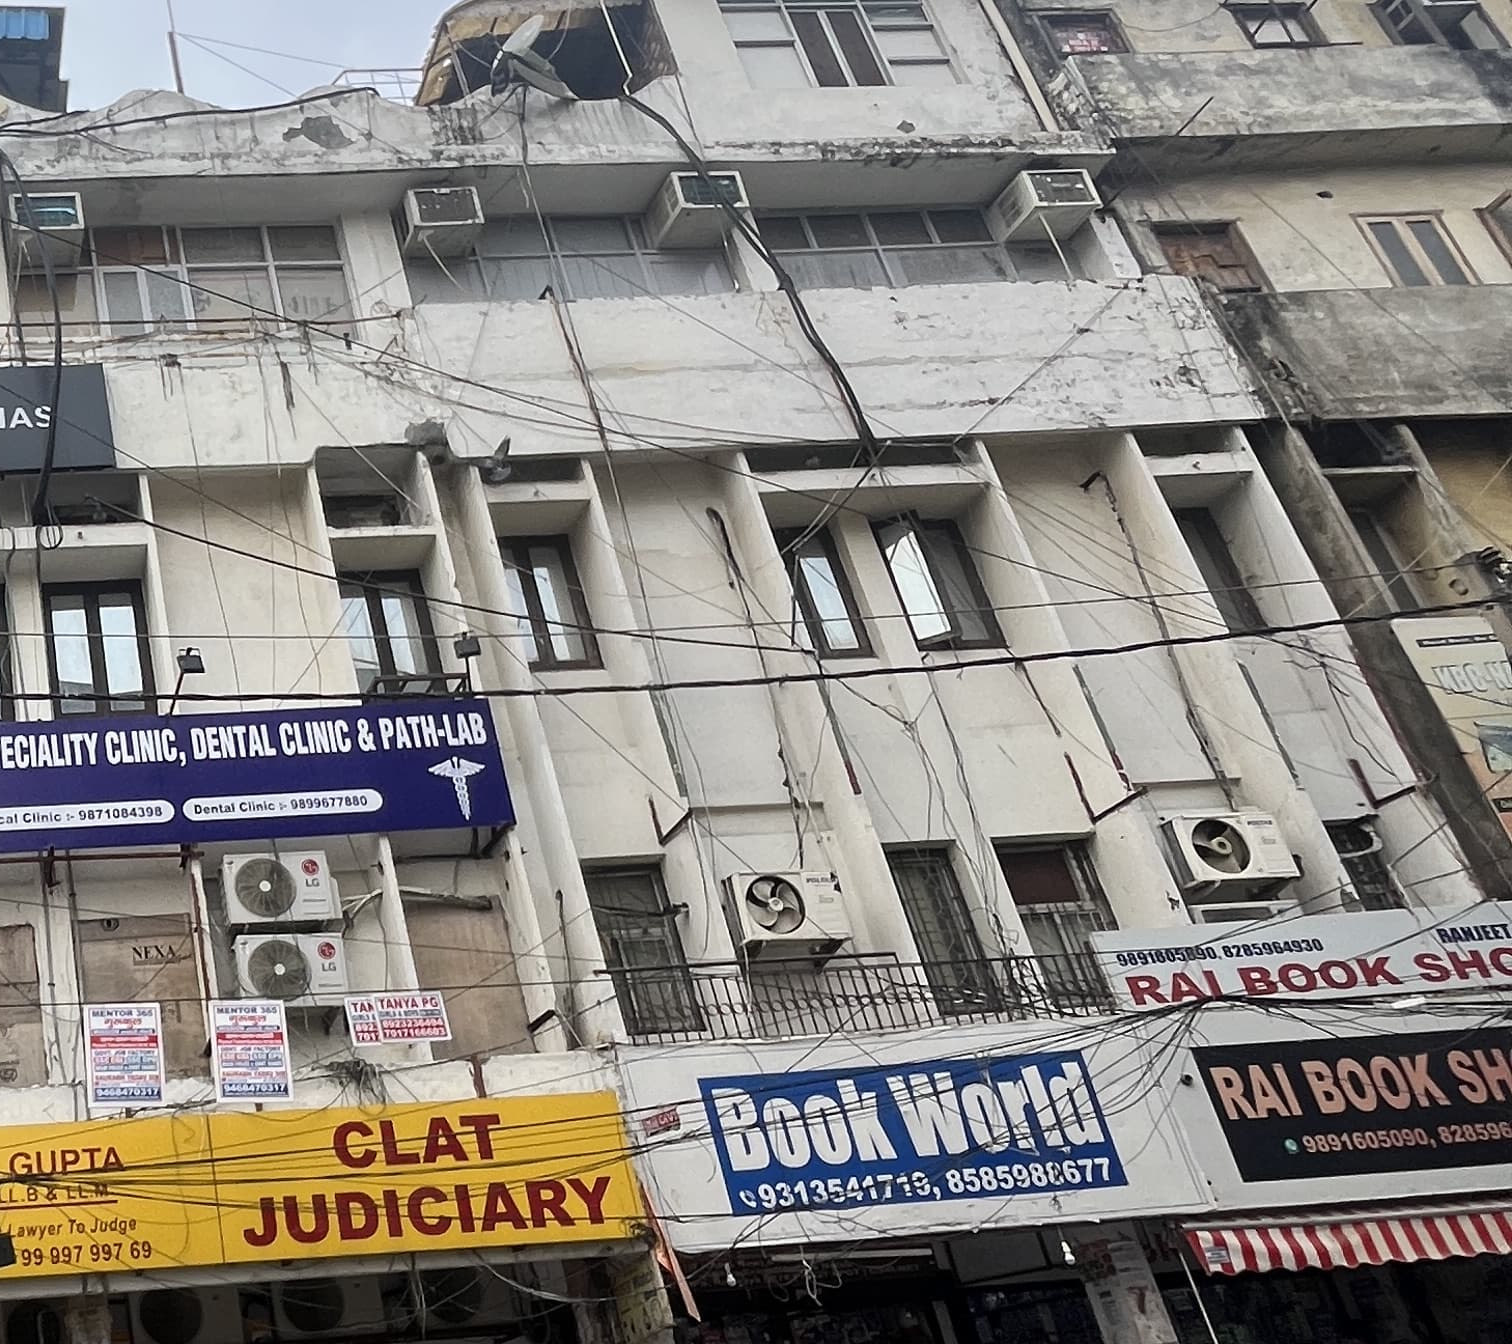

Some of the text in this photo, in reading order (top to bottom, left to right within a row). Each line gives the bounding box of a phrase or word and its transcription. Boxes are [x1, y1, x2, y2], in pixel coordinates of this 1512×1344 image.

[104, 725, 188, 767] CLINIC,
[190, 723, 277, 762] DENTAL
[278, 718, 354, 757] CLINIC
[378, 711, 488, 750] PATH-LAB
[22, 811, 63, 824] Clinic
[77, 805, 164, 822] 9871084398
[193, 796, 369, 816] Dental Clinic 9899677880
[304, 877, 321, 889] LG
[1436, 922, 1512, 944] RANJEET
[1221, 936, 1324, 960] 8285964930
[320, 961, 338, 973] LG
[1125, 955, 1403, 1007] RAI BOOK
[92, 1008, 153, 1018] MENTOR 365
[216, 1005, 278, 1015] MENTOR 365
[378, 995, 439, 1010] TANYA PG
[1209, 1051, 1452, 1122] RAI BOOK
[710, 1061, 1107, 1173] Book World
[332, 1113, 502, 1170] CLAT
[1301, 1127, 1437, 1155] 9891605090,
[8, 1145, 126, 1178] GUPTA
[242, 1175, 612, 1248] JUDICIARY
[7, 1219, 65, 1243] Lawyer
[67, 1218, 87, 1235] To
[89, 1216, 138, 1237] Judge
[20, 1248, 44, 1266] 99
[49, 1245, 84, 1265] 997
[88, 1242, 124, 1262] 997
[128, 1239, 153, 1259] 69
